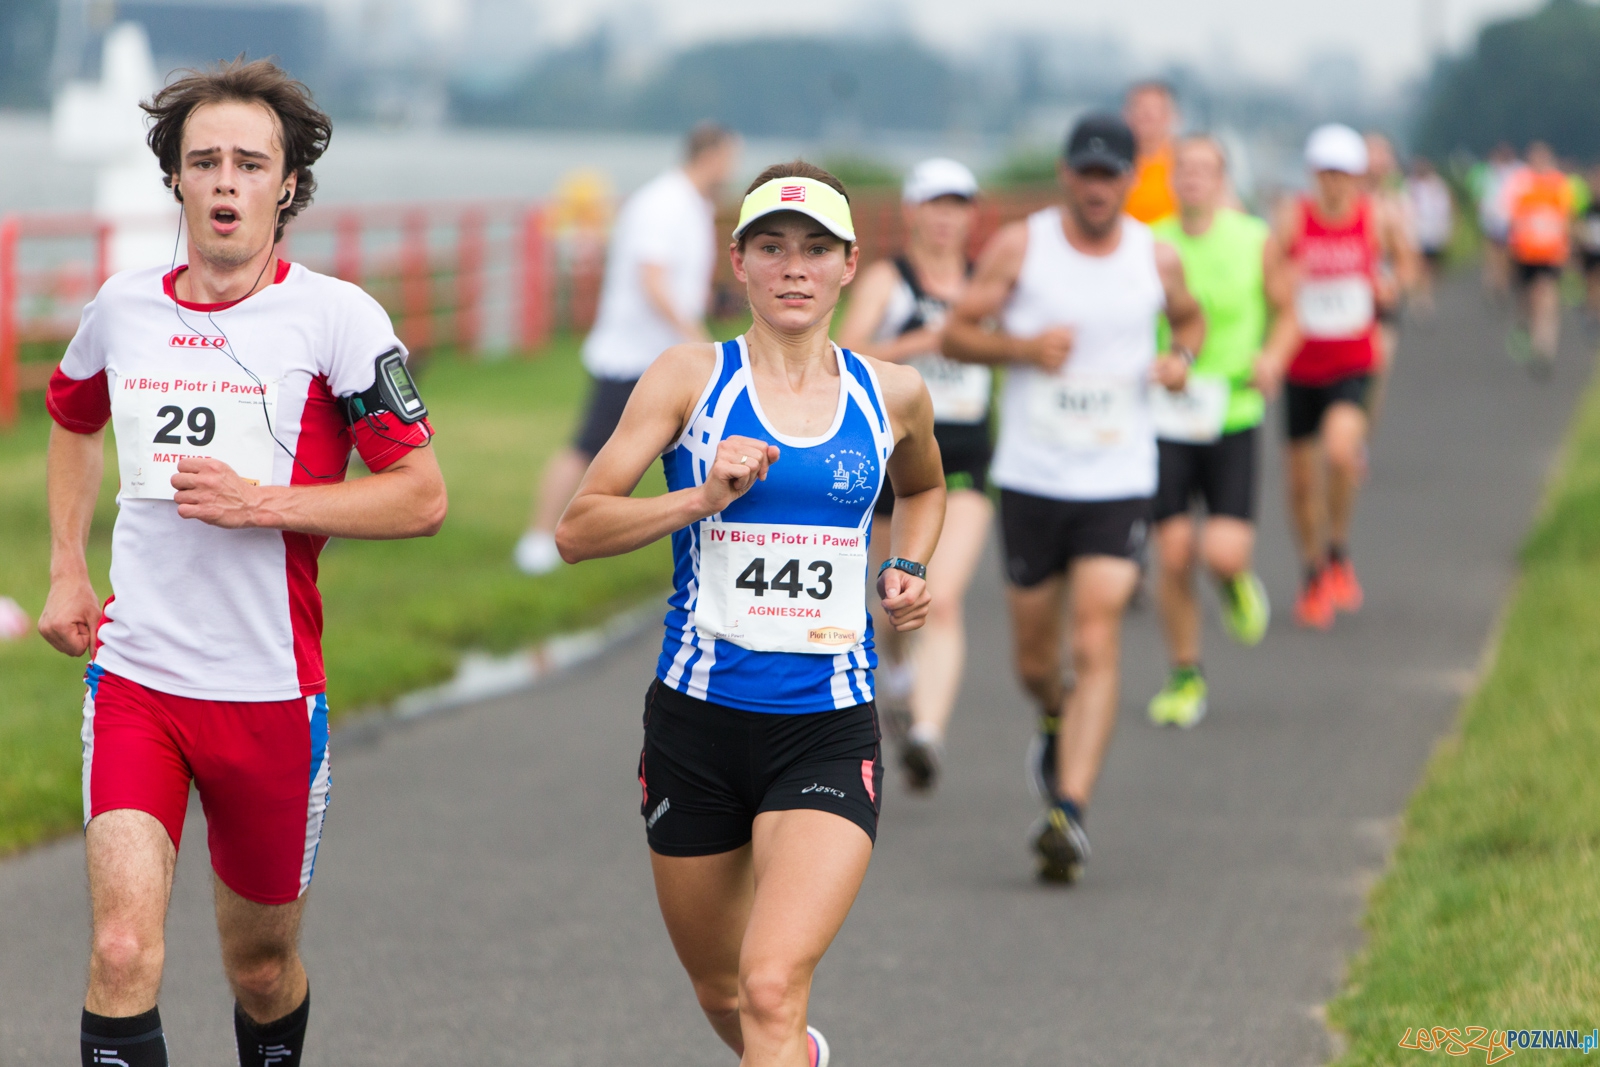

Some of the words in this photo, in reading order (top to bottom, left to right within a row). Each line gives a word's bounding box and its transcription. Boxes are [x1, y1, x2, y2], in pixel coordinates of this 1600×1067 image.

[124, 379, 137, 390] IV
[138, 378, 169, 393] Bieg
[174, 379, 208, 392] Piotr
[212, 380, 216, 392] i
[221, 381, 268, 395] Paweł
[152, 405, 216, 446] 29
[711, 529, 726, 541] IV
[731, 531, 766, 546] Bieg
[771, 532, 808, 545] Piotr
[813, 533, 817, 545] i
[822, 534, 859, 548] Paweł
[735, 557, 833, 601] 443
[748, 606, 822, 618] AGNIESZKA
[809, 631, 828, 639] Piotr
[833, 632, 855, 640] Paweł
[815, 784, 846, 798] asics
